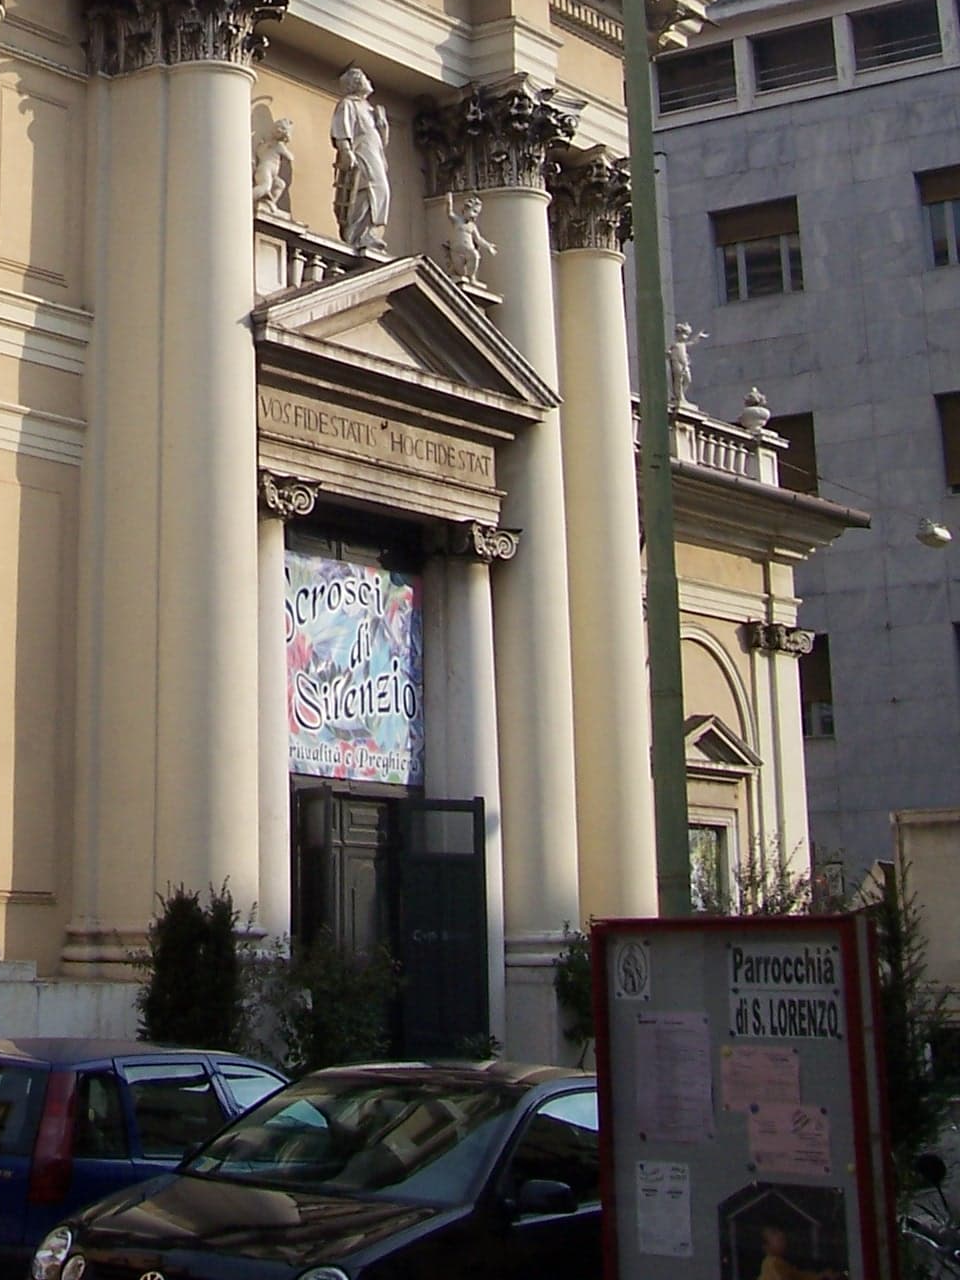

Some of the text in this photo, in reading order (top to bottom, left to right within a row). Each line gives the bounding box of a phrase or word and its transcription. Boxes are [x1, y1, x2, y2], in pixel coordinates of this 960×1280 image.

[260, 395, 292, 425] VOS
[350, 622, 371, 666] di
[294, 658, 417, 730] Silenzio
[345, 751, 352, 765] e
[735, 998, 839, 1038] di S. LORENZO
